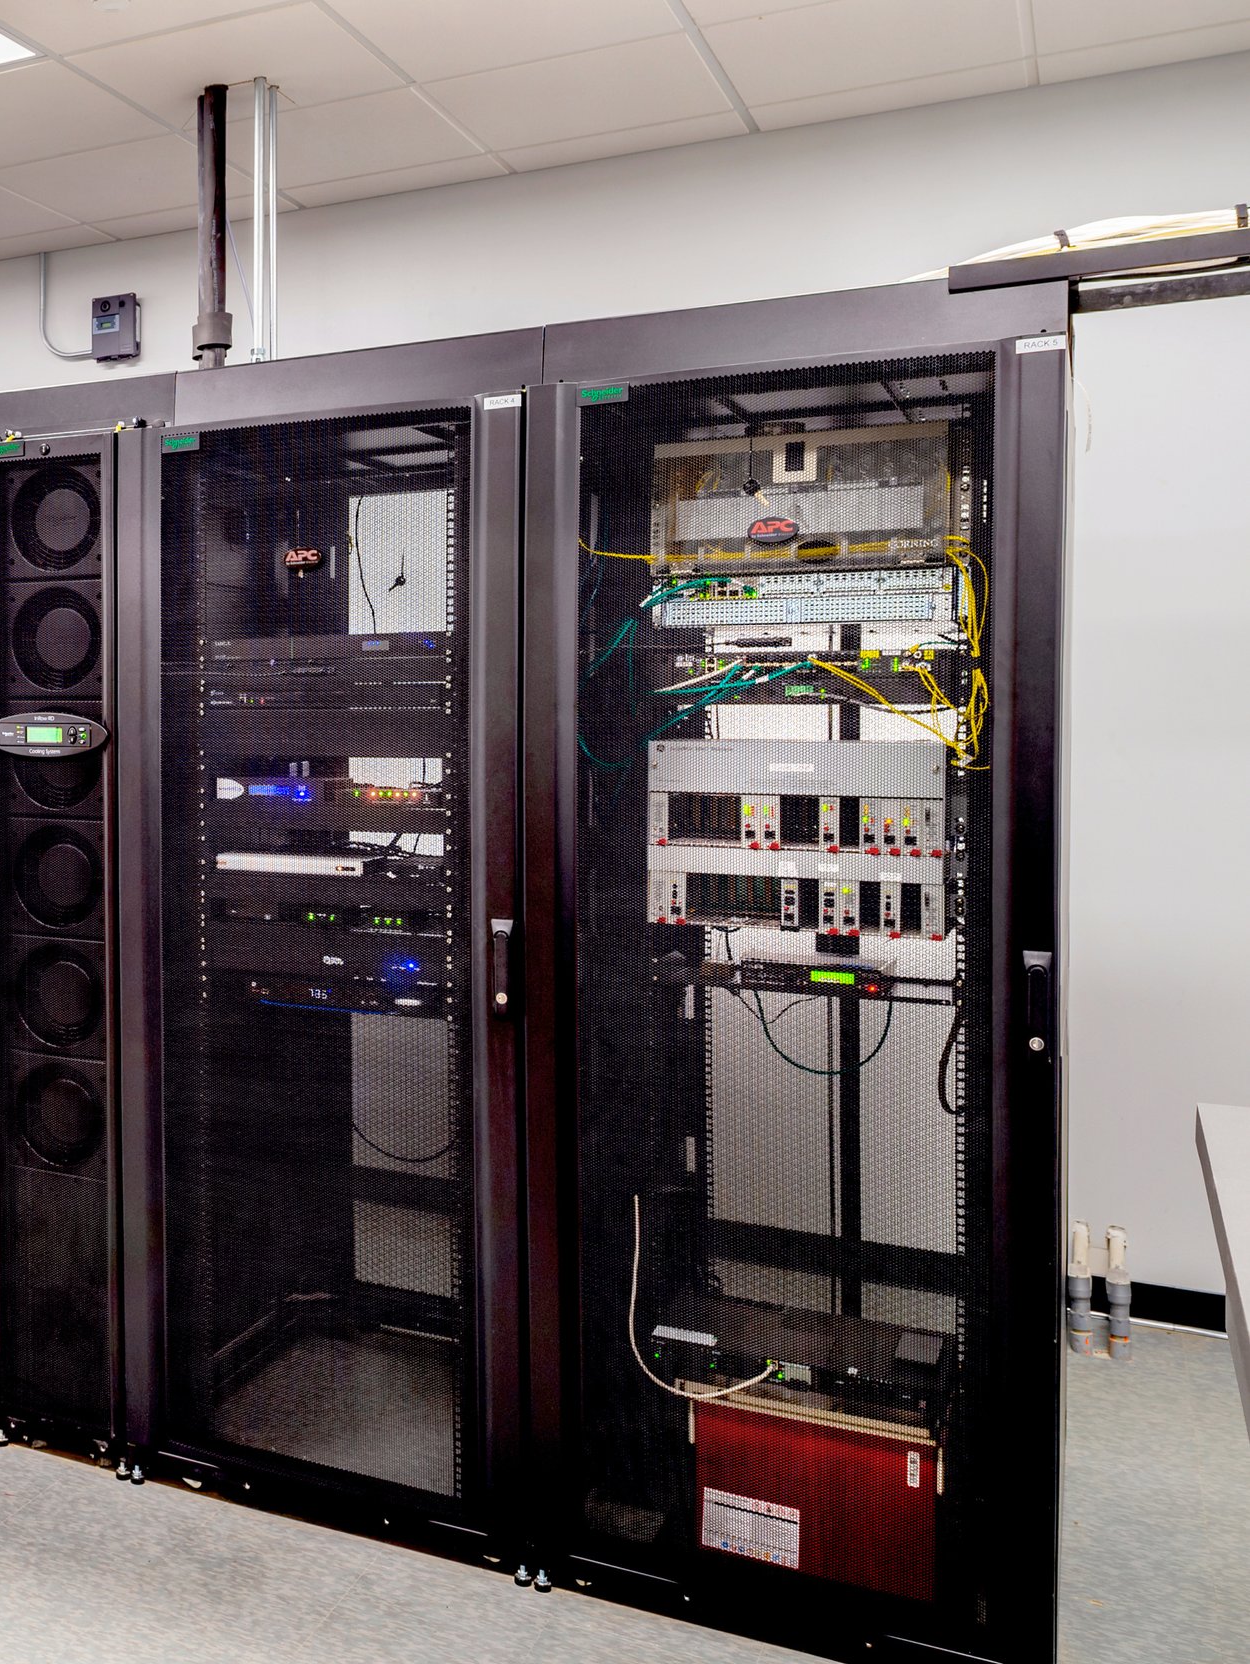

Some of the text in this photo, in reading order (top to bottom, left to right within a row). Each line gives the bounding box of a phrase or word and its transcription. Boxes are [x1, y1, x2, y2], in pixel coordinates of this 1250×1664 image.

[1023, 338, 1058, 349] RACK 5
[581, 386, 623, 402] Schneider
[751, 520, 794, 533] APC
[285, 550, 318, 562] APC
